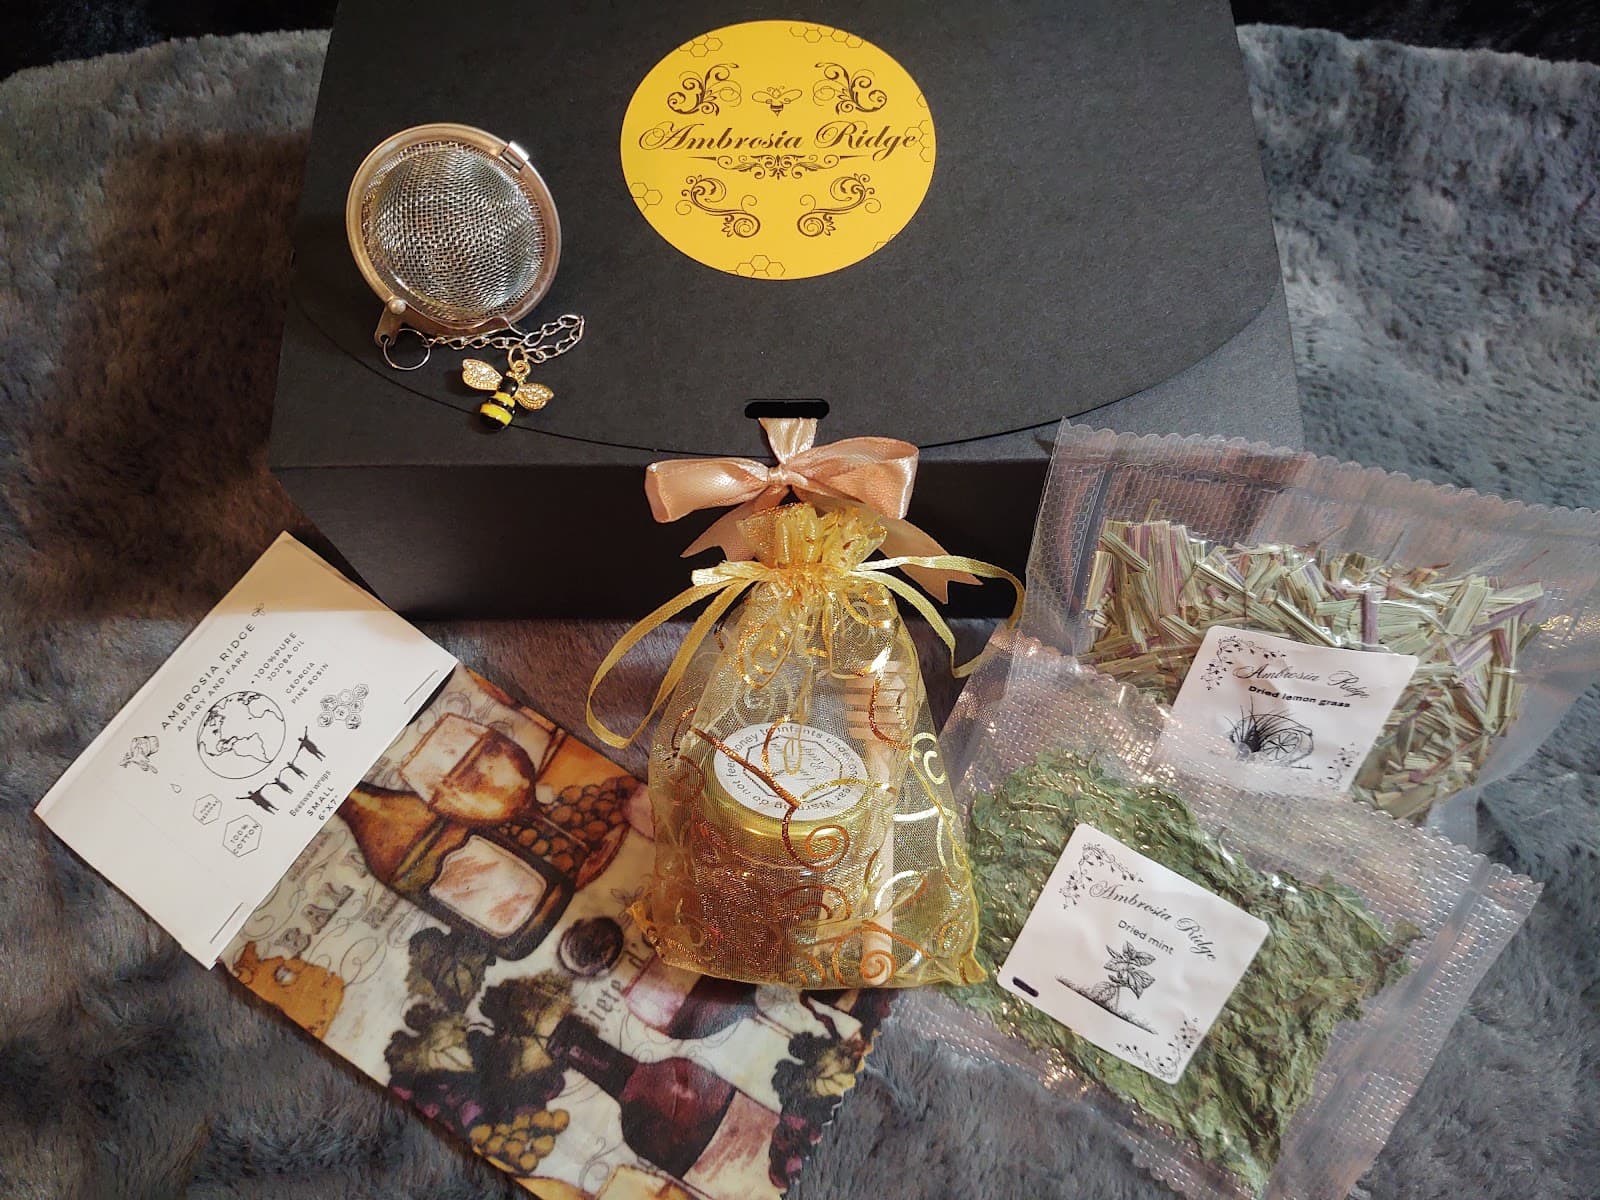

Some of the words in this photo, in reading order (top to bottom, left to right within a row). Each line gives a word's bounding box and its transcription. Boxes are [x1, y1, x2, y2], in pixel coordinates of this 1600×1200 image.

[638, 120, 803, 150] Ambrosia
[815, 119, 919, 162] Ridge
[161, 664, 219, 731] AMBROSIA
[220, 623, 256, 662] RIDGE
[267, 652, 292, 682] JOJOBA
[292, 640, 305, 652] OIL
[285, 661, 316, 695] GEORGIA
[177, 698, 207, 732] APIARY
[208, 677, 226, 696] AND
[226, 650, 250, 676] FARM
[291, 683, 309, 704] PINE
[308, 662, 329, 684] ROSIN
[1233, 663, 1320, 683] Ambrosia
[1327, 670, 1371, 698] Ridge
[1248, 685, 1280, 699] Dried
[1281, 692, 1316, 704] lemon
[1318, 698, 1351, 709] grass
[307, 785, 335, 817] SMALL
[230, 824, 248, 844] 100%
[233, 823, 260, 854] COTTON
[1089, 879, 1172, 922] Ambrosia
[1175, 917, 1217, 962] Ridge
[1117, 919, 1148, 940] Dried
[1148, 936, 1175, 955] mint
